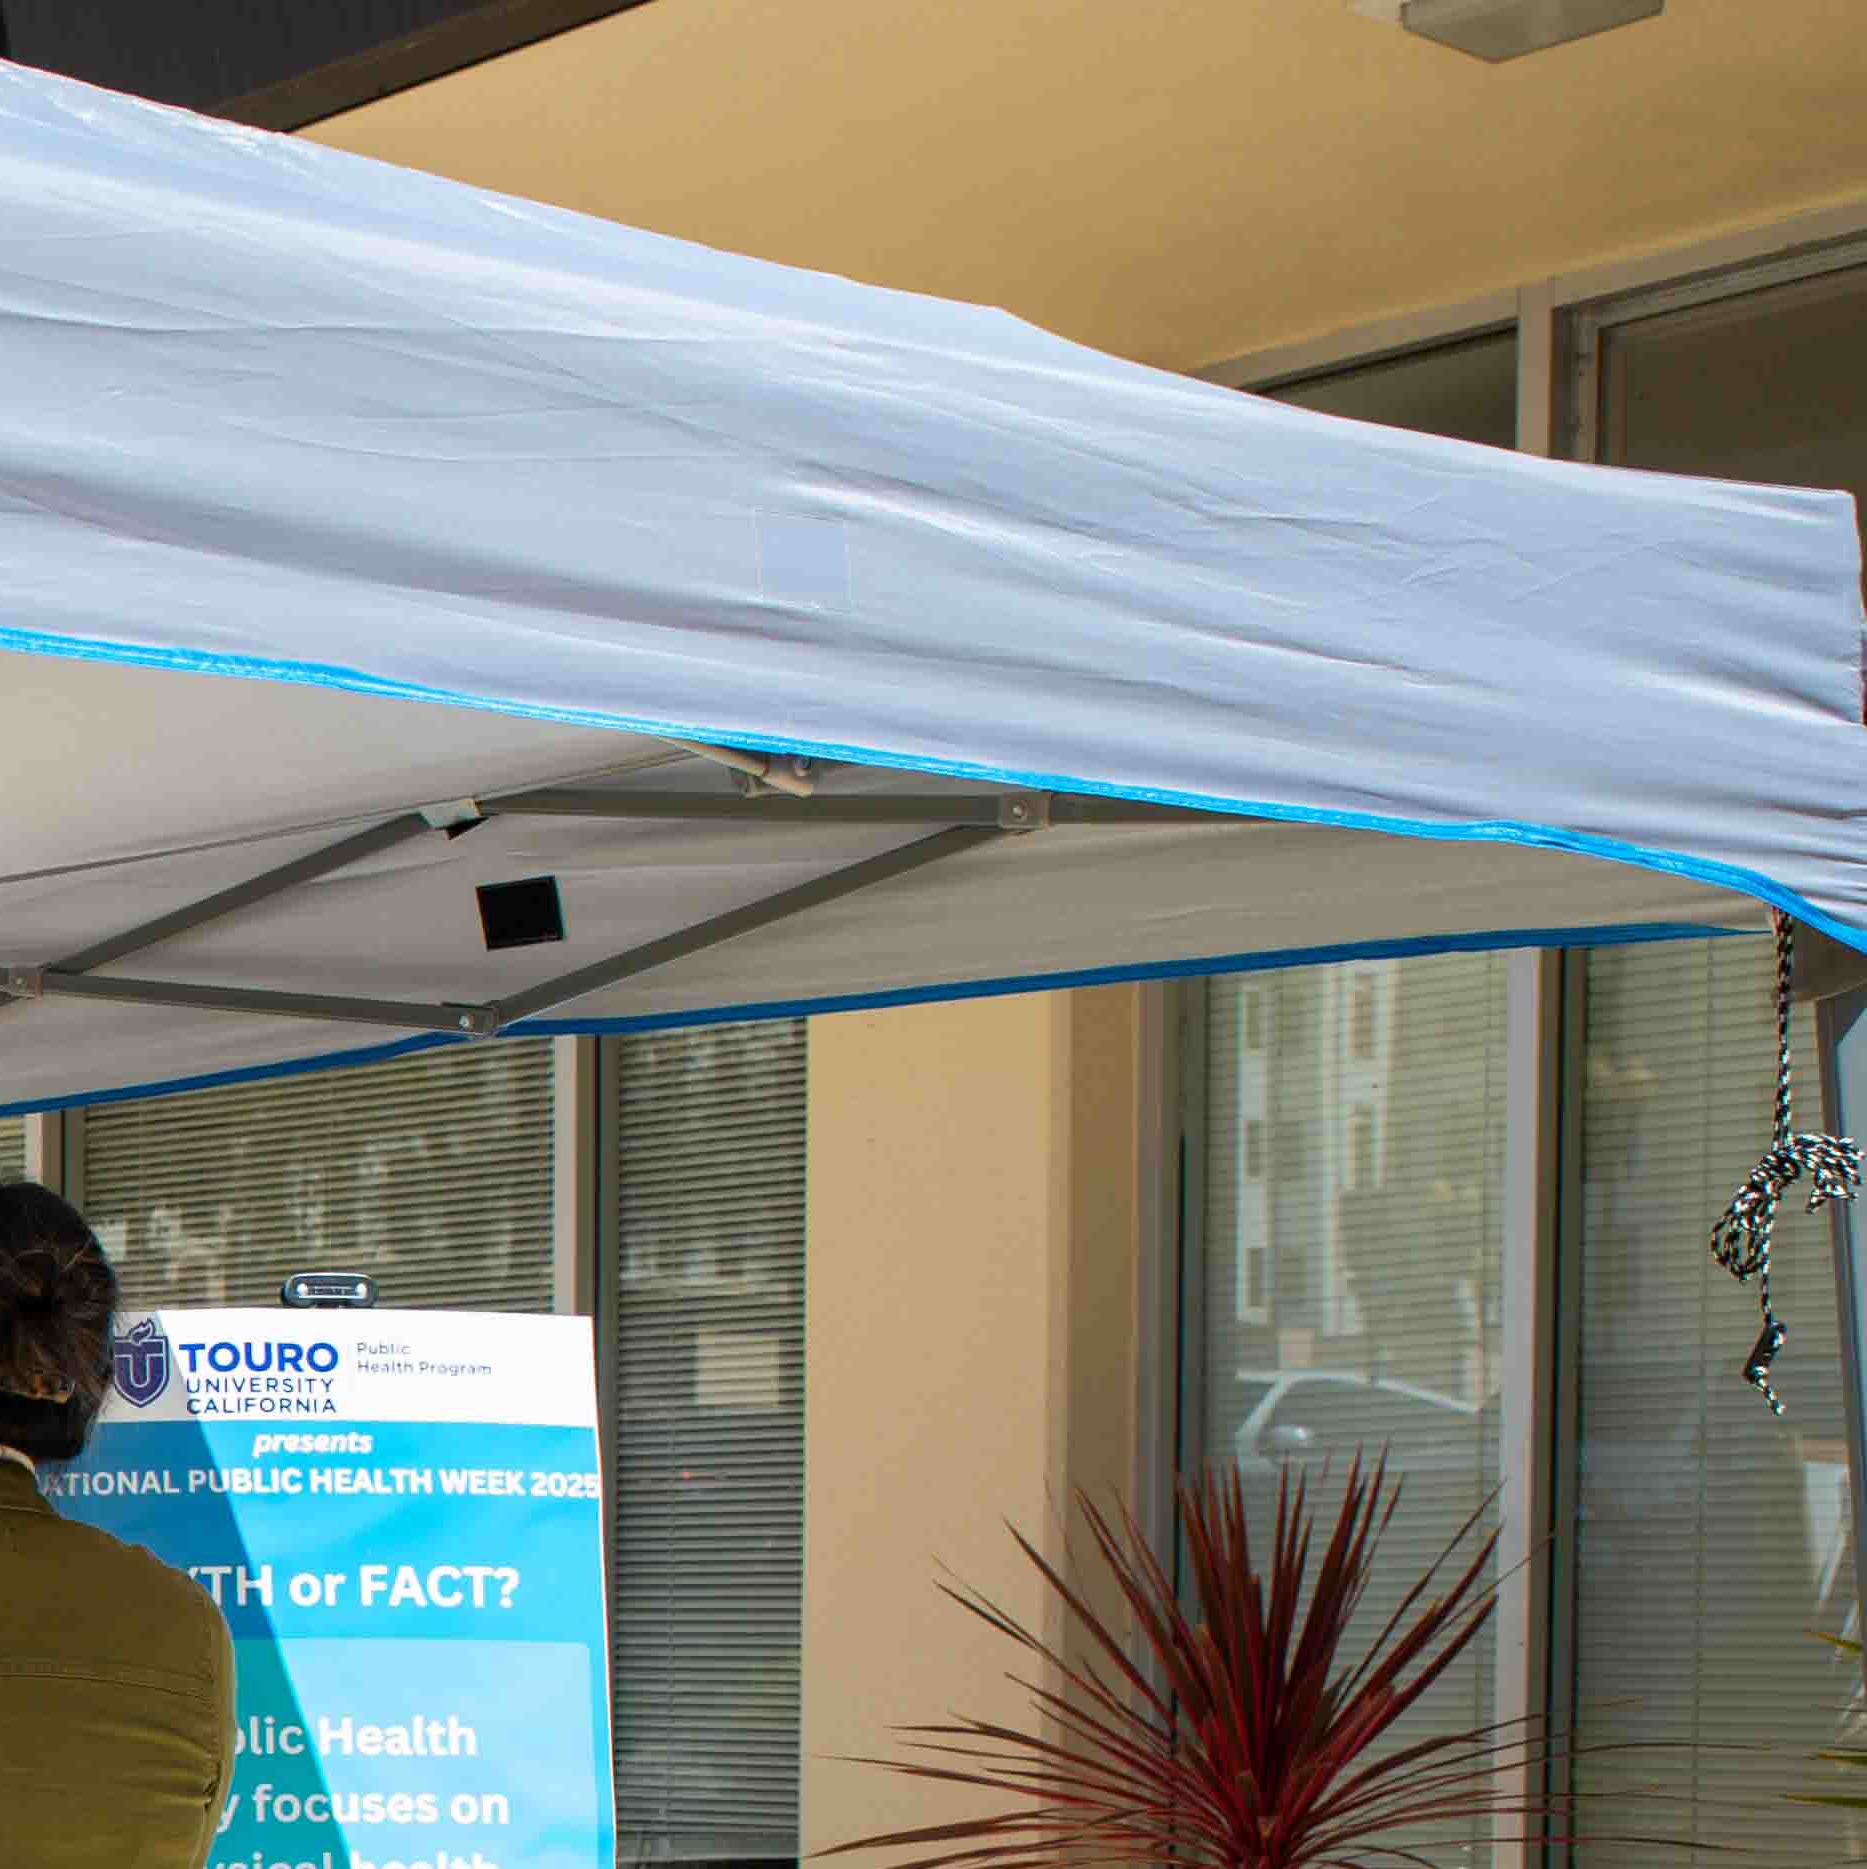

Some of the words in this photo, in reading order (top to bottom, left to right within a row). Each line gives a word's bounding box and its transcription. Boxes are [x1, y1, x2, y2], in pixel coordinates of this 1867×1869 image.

[179, 1342, 338, 1372] TOURO
[357, 1341, 410, 1356] Public
[357, 1360, 414, 1375] Health
[419, 1362, 492, 1377] Program
[184, 1378, 332, 1394] UNIVERSITY
[187, 1398, 336, 1415] CALIFORNIA
[254, 1431, 373, 1456] presents
[191, 1469, 303, 1495] PUBLIC
[310, 1467, 434, 1495] HEALTH
[443, 1469, 525, 1496] WEEK
[530, 1471, 601, 1499] 2025
[289, 1571, 345, 1608] or
[359, 1565, 520, 1608] FACT?
[319, 1716, 478, 1756] Health
[254, 1784, 438, 1825] focuses
[450, 1792, 510, 1825] on
